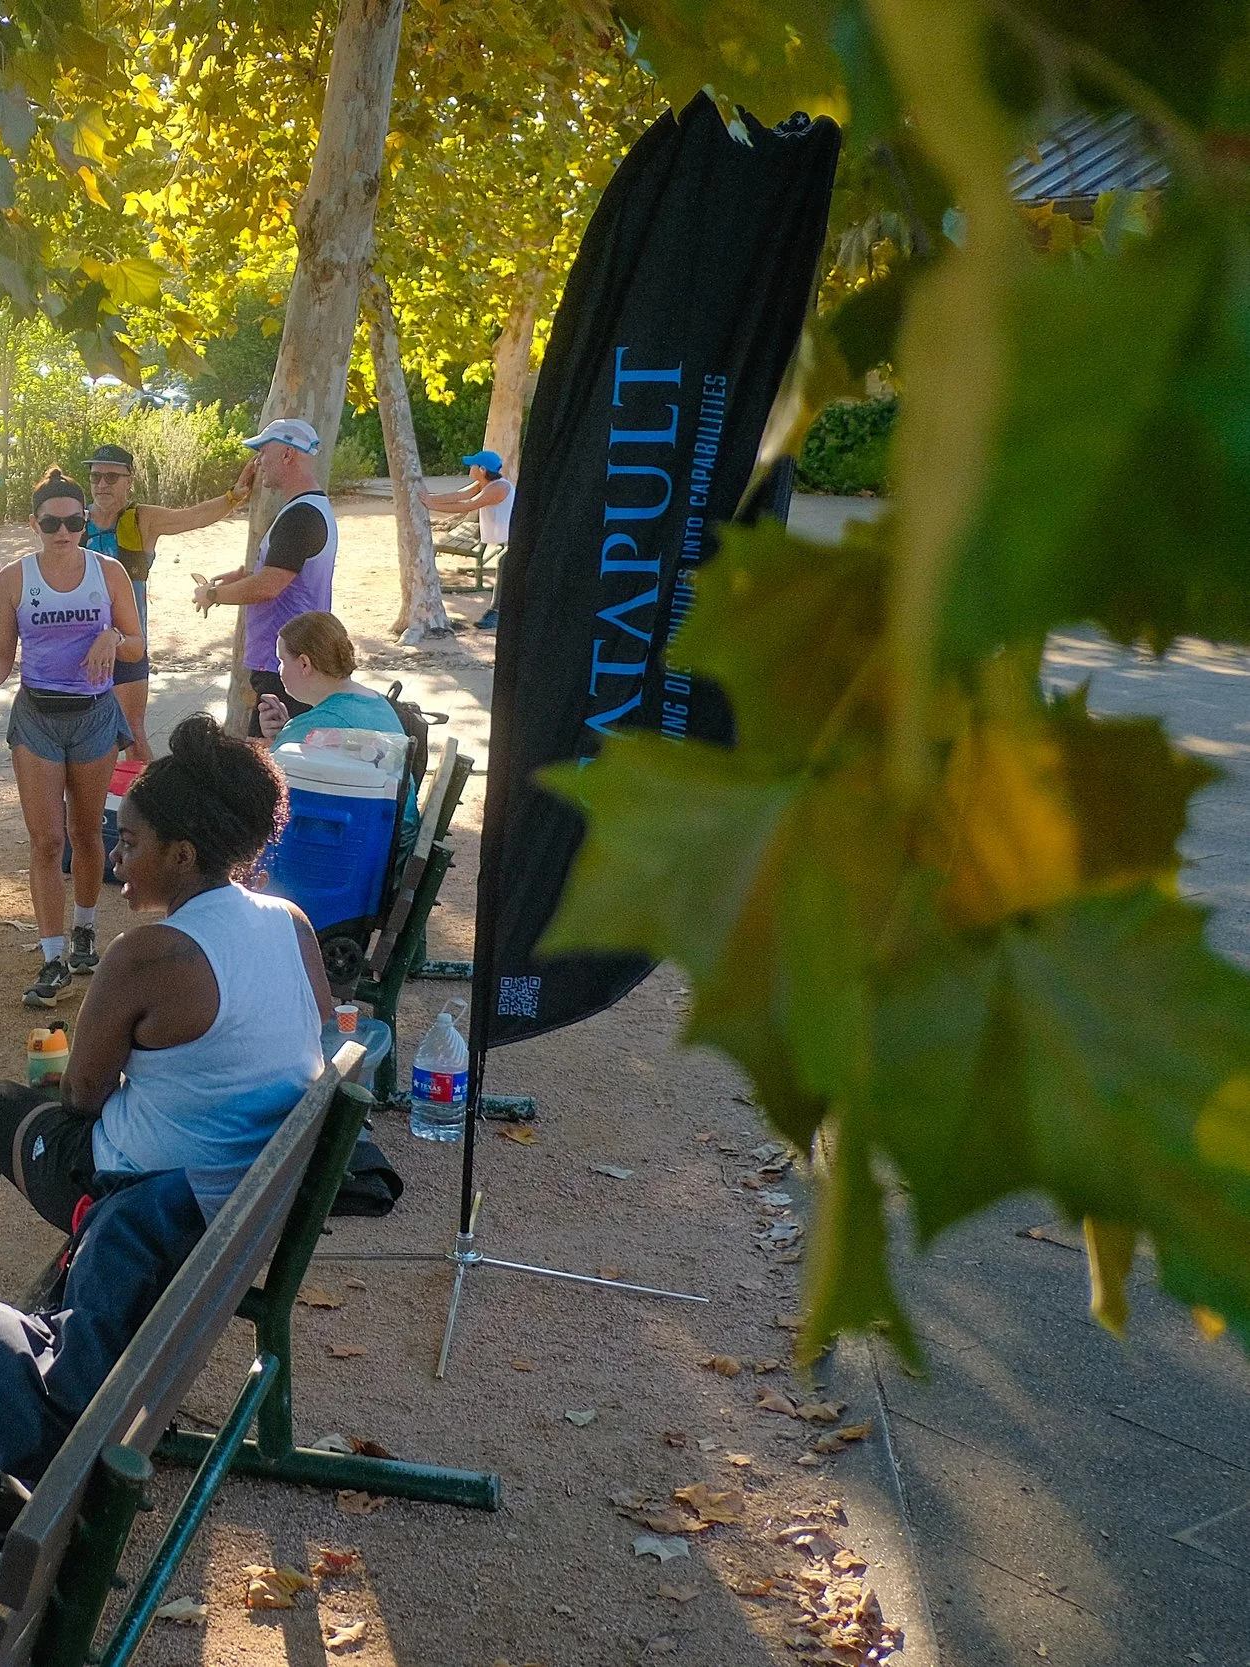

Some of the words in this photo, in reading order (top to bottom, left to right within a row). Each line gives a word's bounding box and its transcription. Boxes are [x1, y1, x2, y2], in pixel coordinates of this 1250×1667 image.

[689, 374, 727, 508] CAPABILITIES
[578, 346, 683, 776] ATAPULT
[681, 515, 704, 561] INTO
[31, 608, 101, 626] CATAPULT
[420, 1082, 442, 1091] TEXAS
